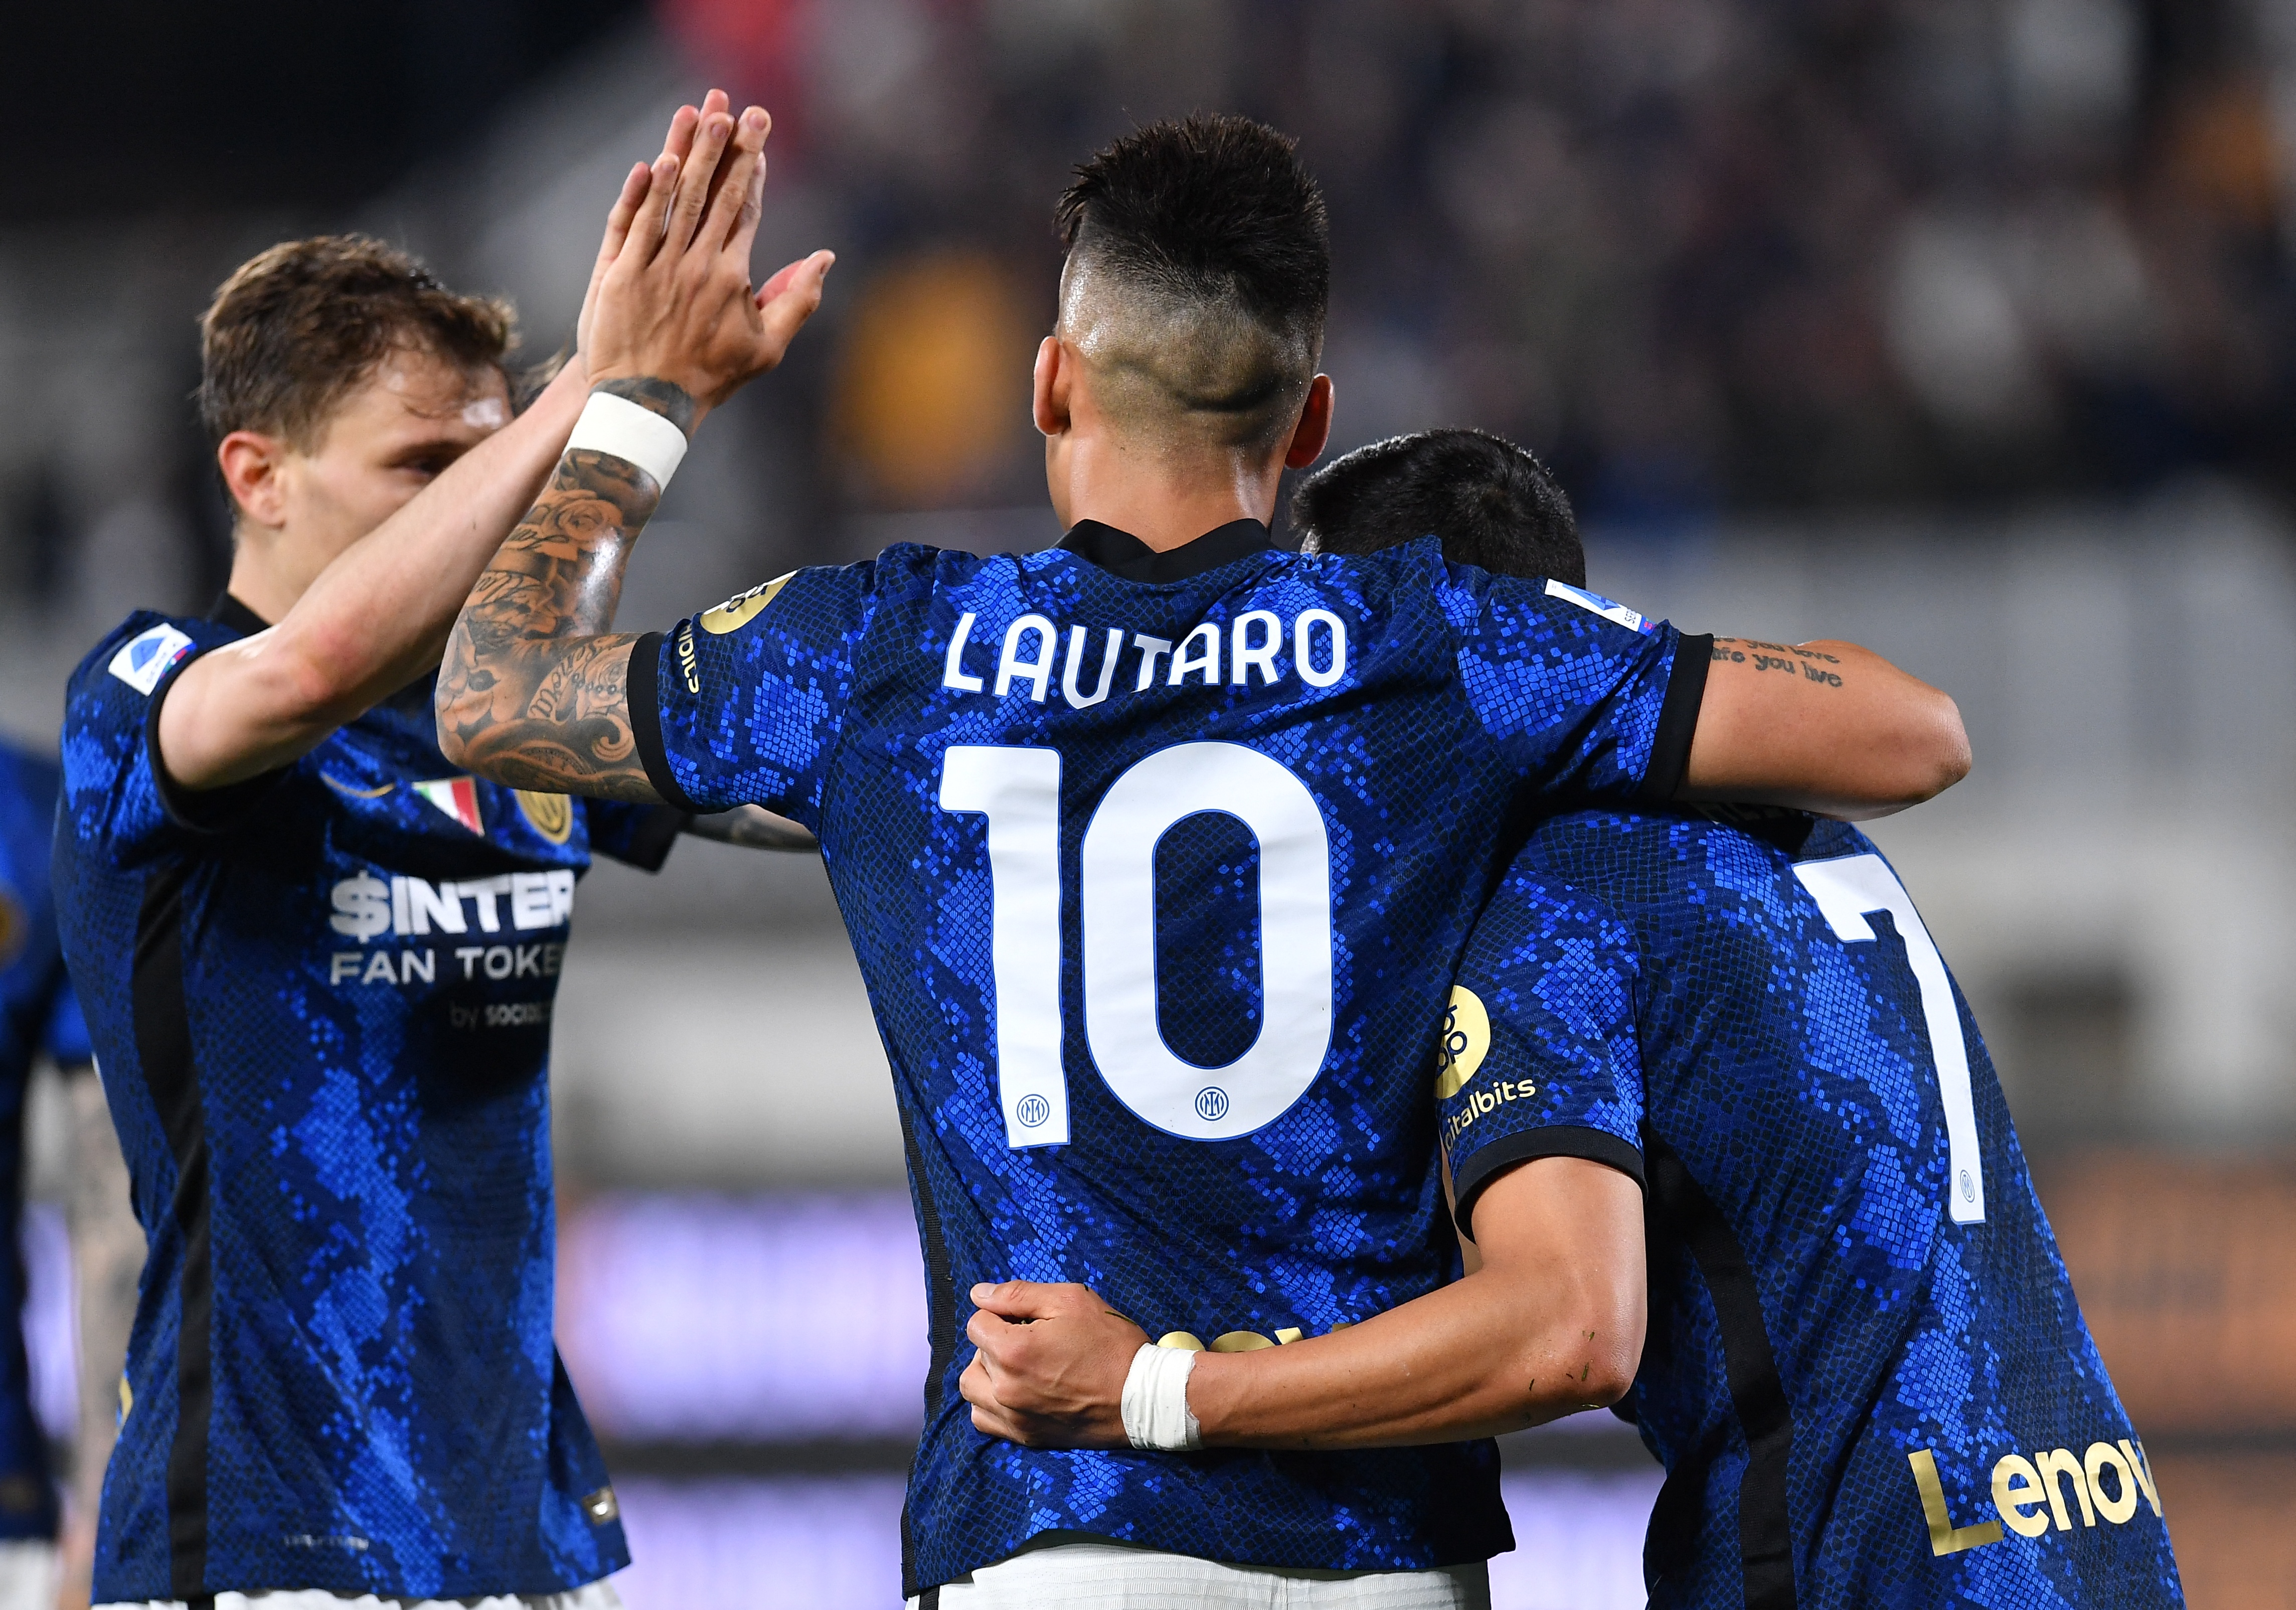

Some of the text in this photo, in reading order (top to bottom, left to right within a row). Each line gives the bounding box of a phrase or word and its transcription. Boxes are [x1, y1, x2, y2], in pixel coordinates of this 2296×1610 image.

[943, 608, 1347, 709] LAUTARO
[1752, 653, 1795, 674] you
[1800, 660, 1843, 688] live
[330, 948, 435, 986] FAN
[938, 740, 1334, 1150] 10
[1791, 853, 1986, 1224] 7
